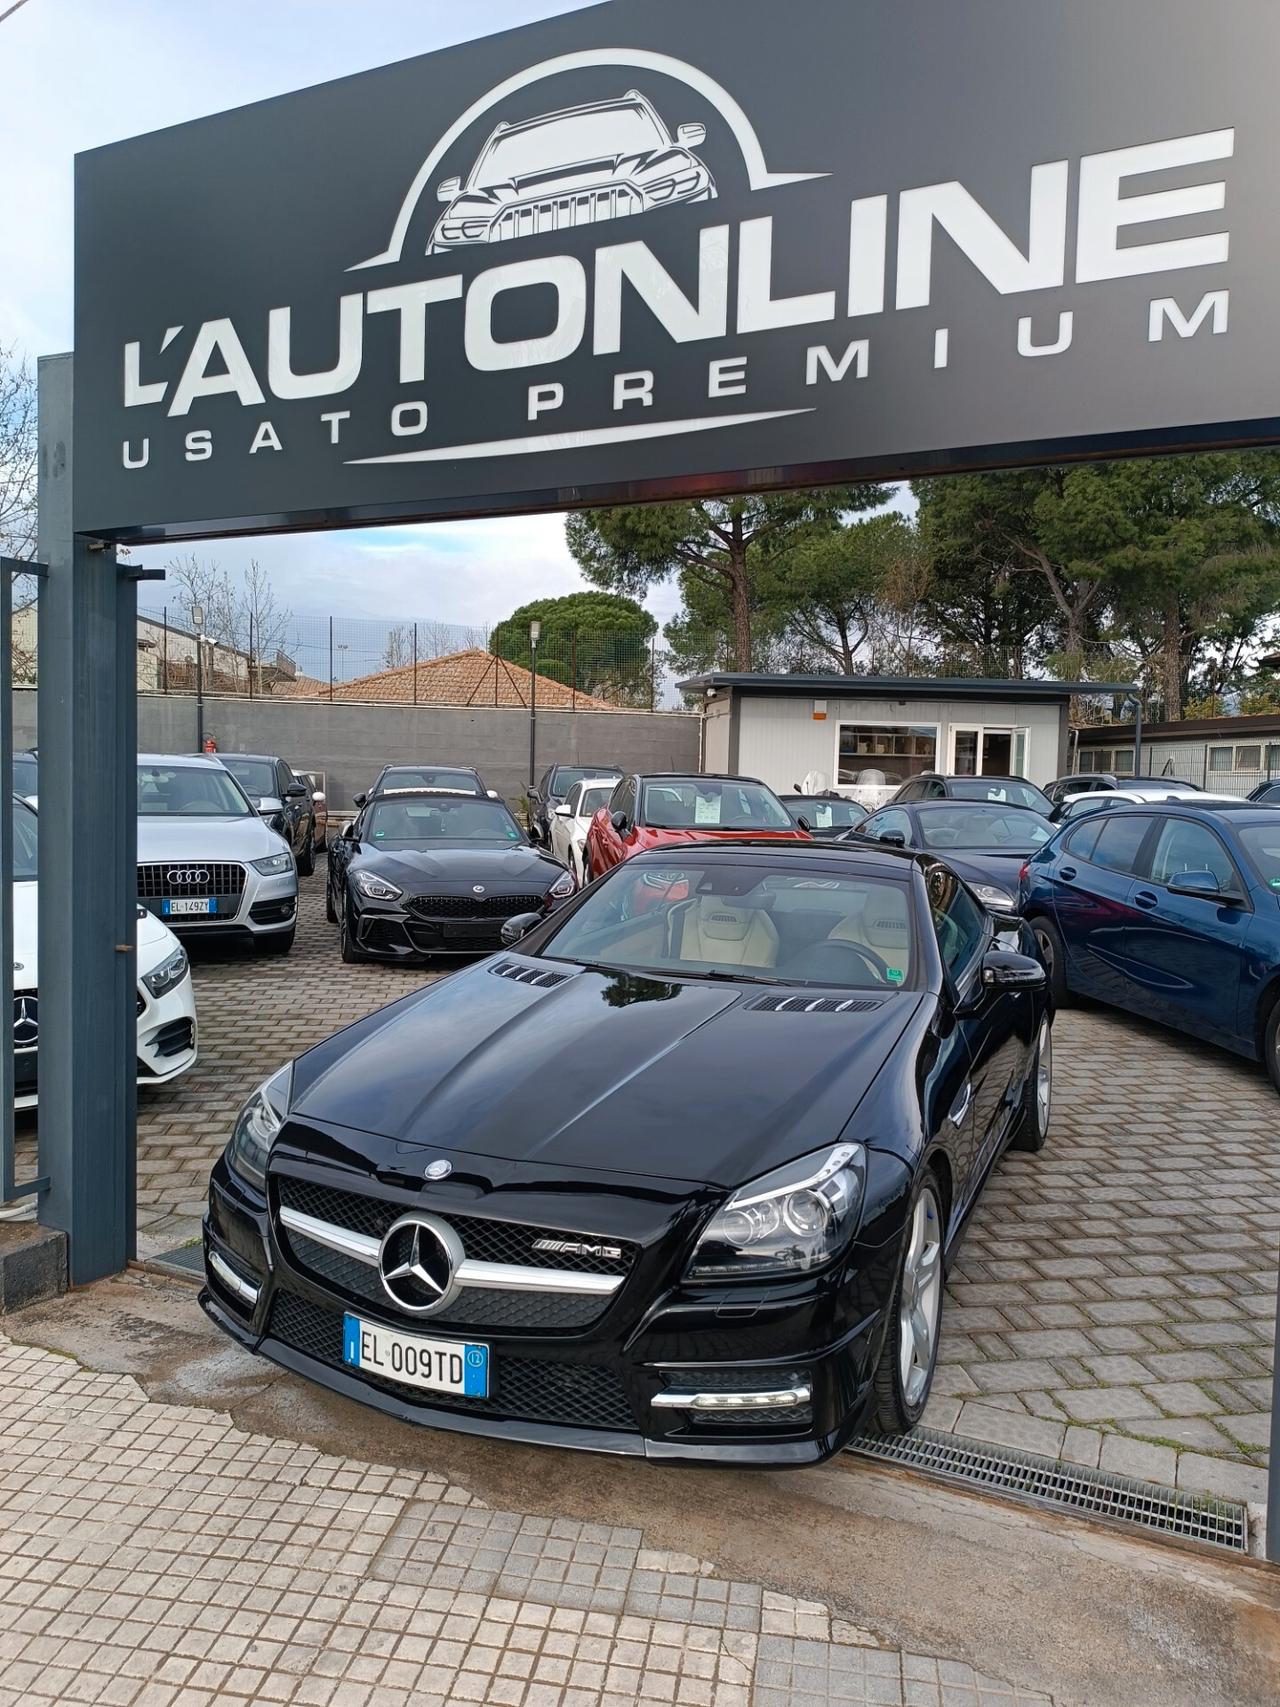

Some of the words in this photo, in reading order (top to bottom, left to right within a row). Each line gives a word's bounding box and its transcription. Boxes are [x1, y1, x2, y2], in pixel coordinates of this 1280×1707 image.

[123, 128, 1236, 417] L'AUTONLINE
[122, 400, 429, 470] USATO
[526, 289, 1230, 422] PREMIUM
[559, 1242, 622, 1260] AMG
[361, 1330, 385, 1367] EL
[391, 1342, 464, 1385] 009TD
